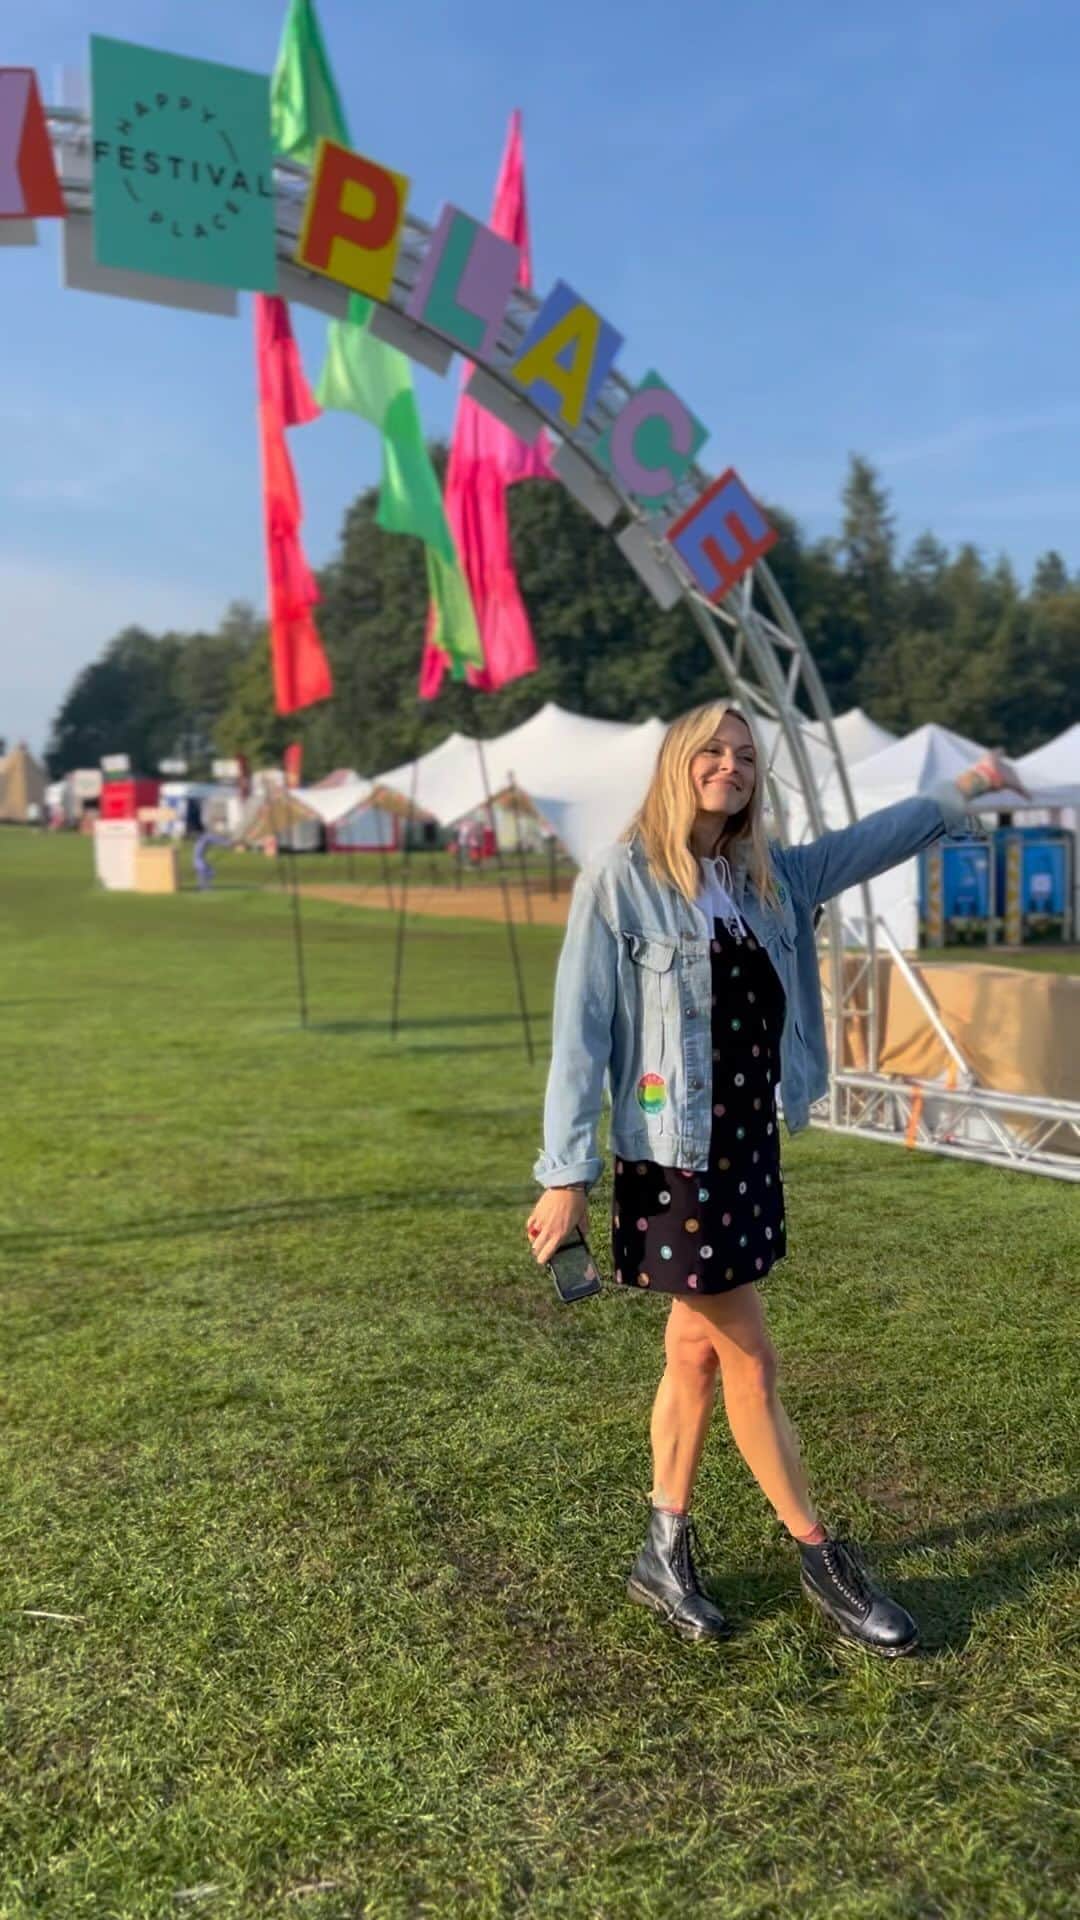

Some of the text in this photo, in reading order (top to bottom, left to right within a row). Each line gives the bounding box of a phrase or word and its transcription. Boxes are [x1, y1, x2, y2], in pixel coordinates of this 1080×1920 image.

[116, 92, 216, 135] HAPPY
[94, 140, 272, 198] FESTIVAL
[302, 139, 779, 606] PLACE
